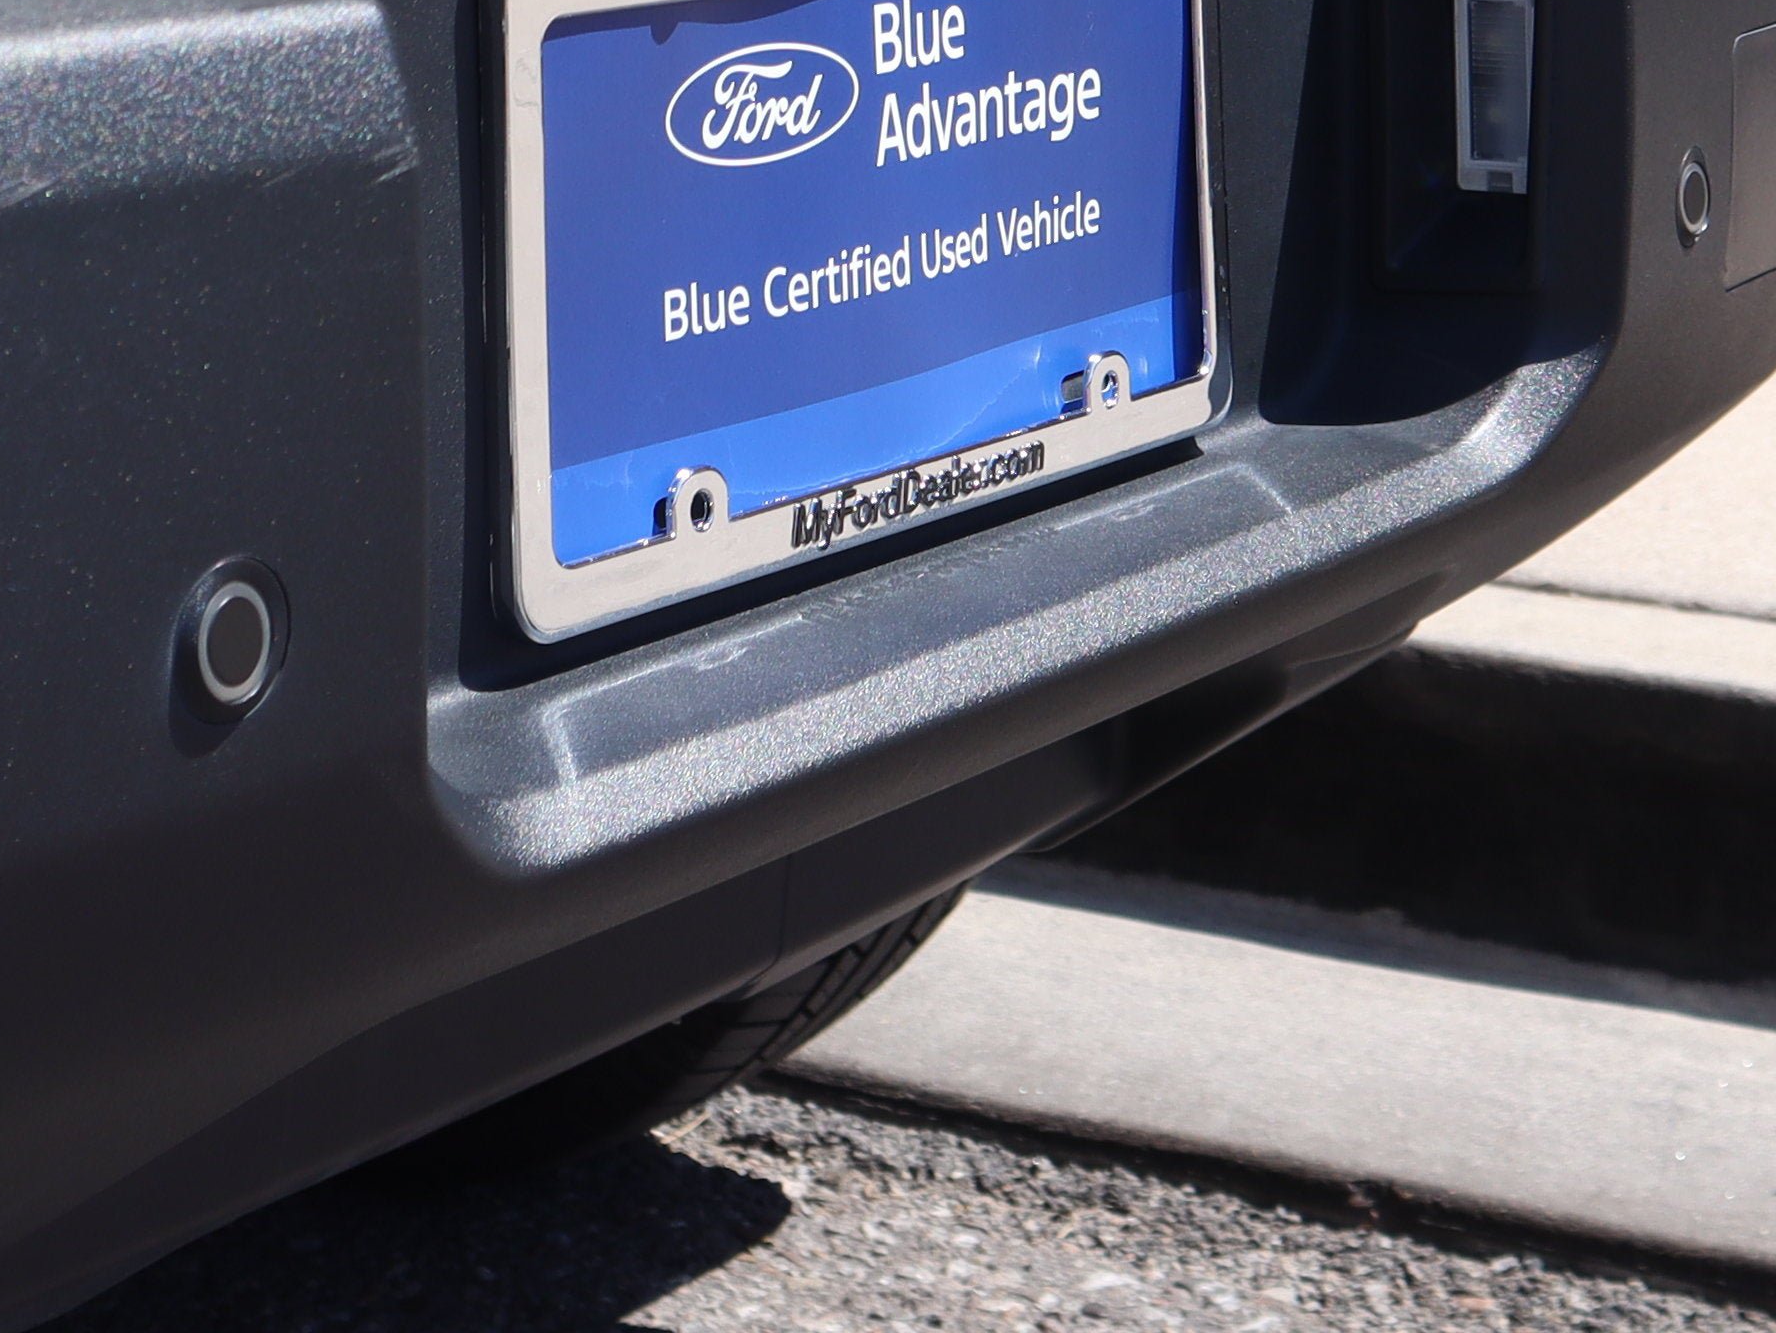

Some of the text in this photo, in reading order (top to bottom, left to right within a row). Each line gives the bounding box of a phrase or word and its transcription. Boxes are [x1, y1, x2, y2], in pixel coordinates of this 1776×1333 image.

[703, 62, 822, 149] Ford
[875, 64, 1101, 166] Advantage
[664, 191, 1100, 342] Blue Certified Used Vehicle
[791, 439, 1045, 550] MyFordDealer.com
